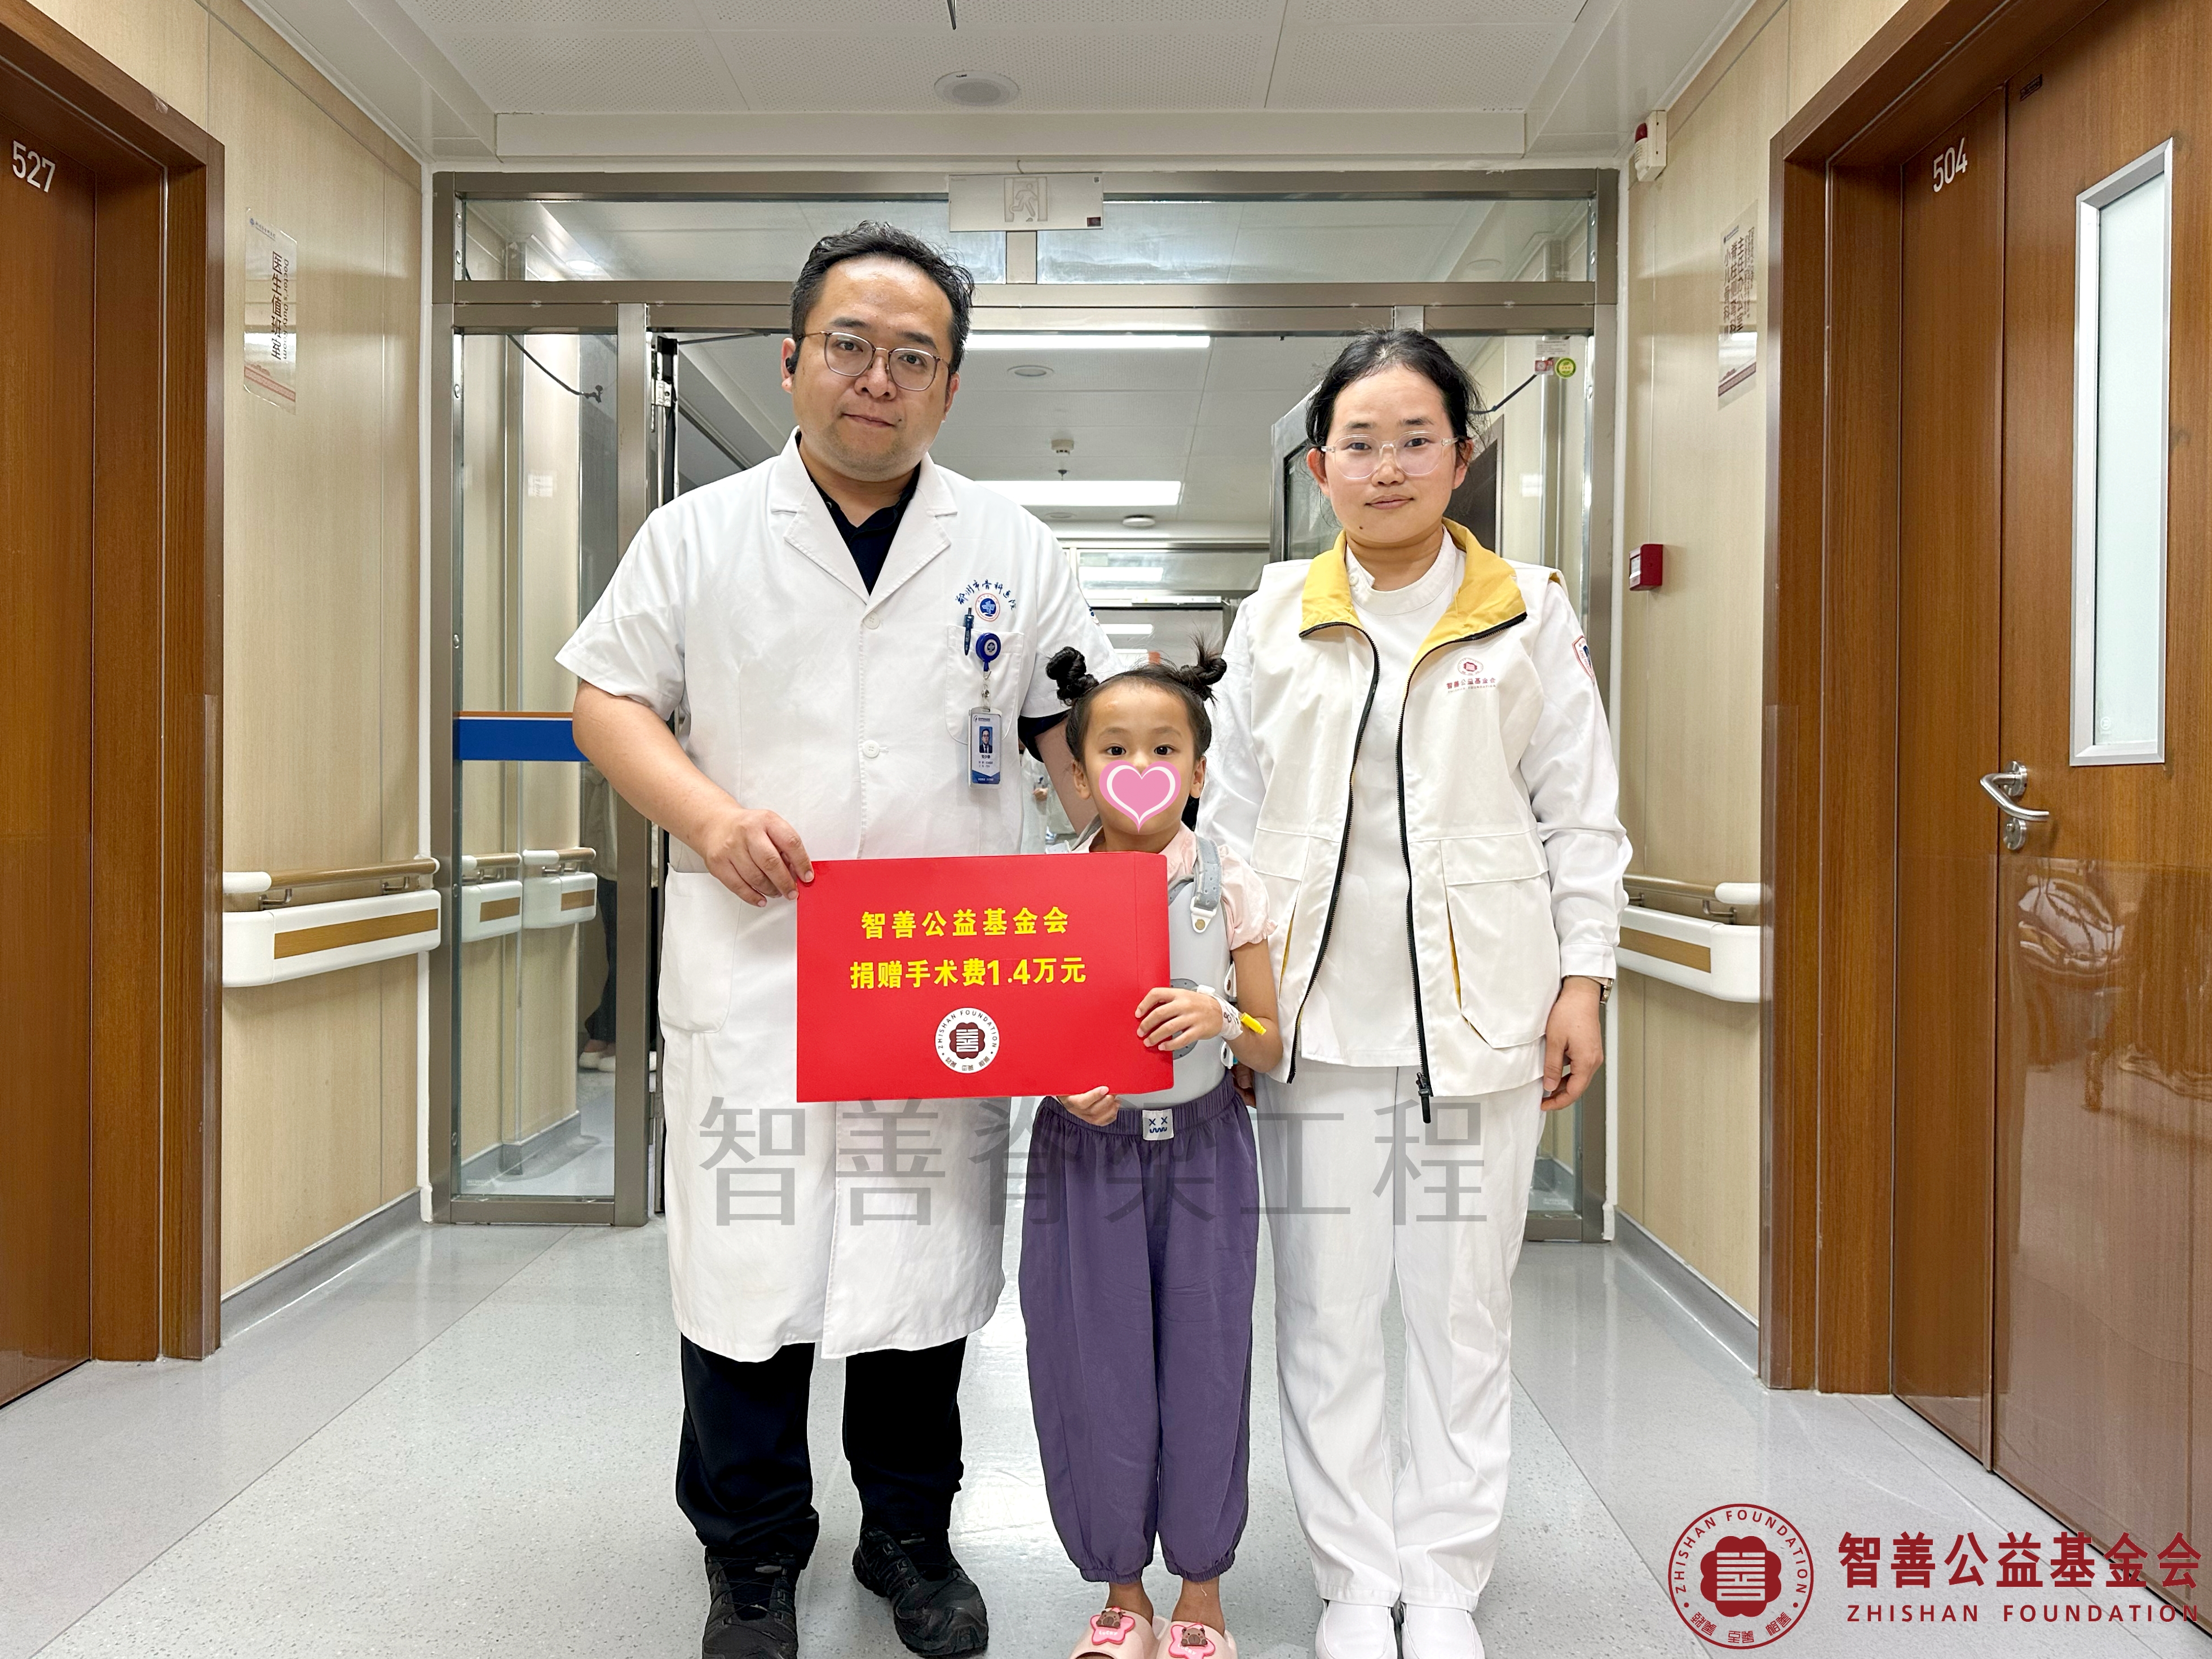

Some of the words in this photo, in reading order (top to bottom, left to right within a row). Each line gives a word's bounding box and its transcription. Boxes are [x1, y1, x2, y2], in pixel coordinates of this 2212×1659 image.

[12, 140, 56, 192] 527
[1933, 137, 1968, 192] 504
[271, 250, 282, 360] 医生值班室
[861, 906, 1069, 939] 智善公益基金会
[850, 956, 1086, 990] 捐赠手术费1.4万元
[938, 1014, 956, 1049] ZHISHAN
[960, 1010, 997, 1048] FOUNDATION
